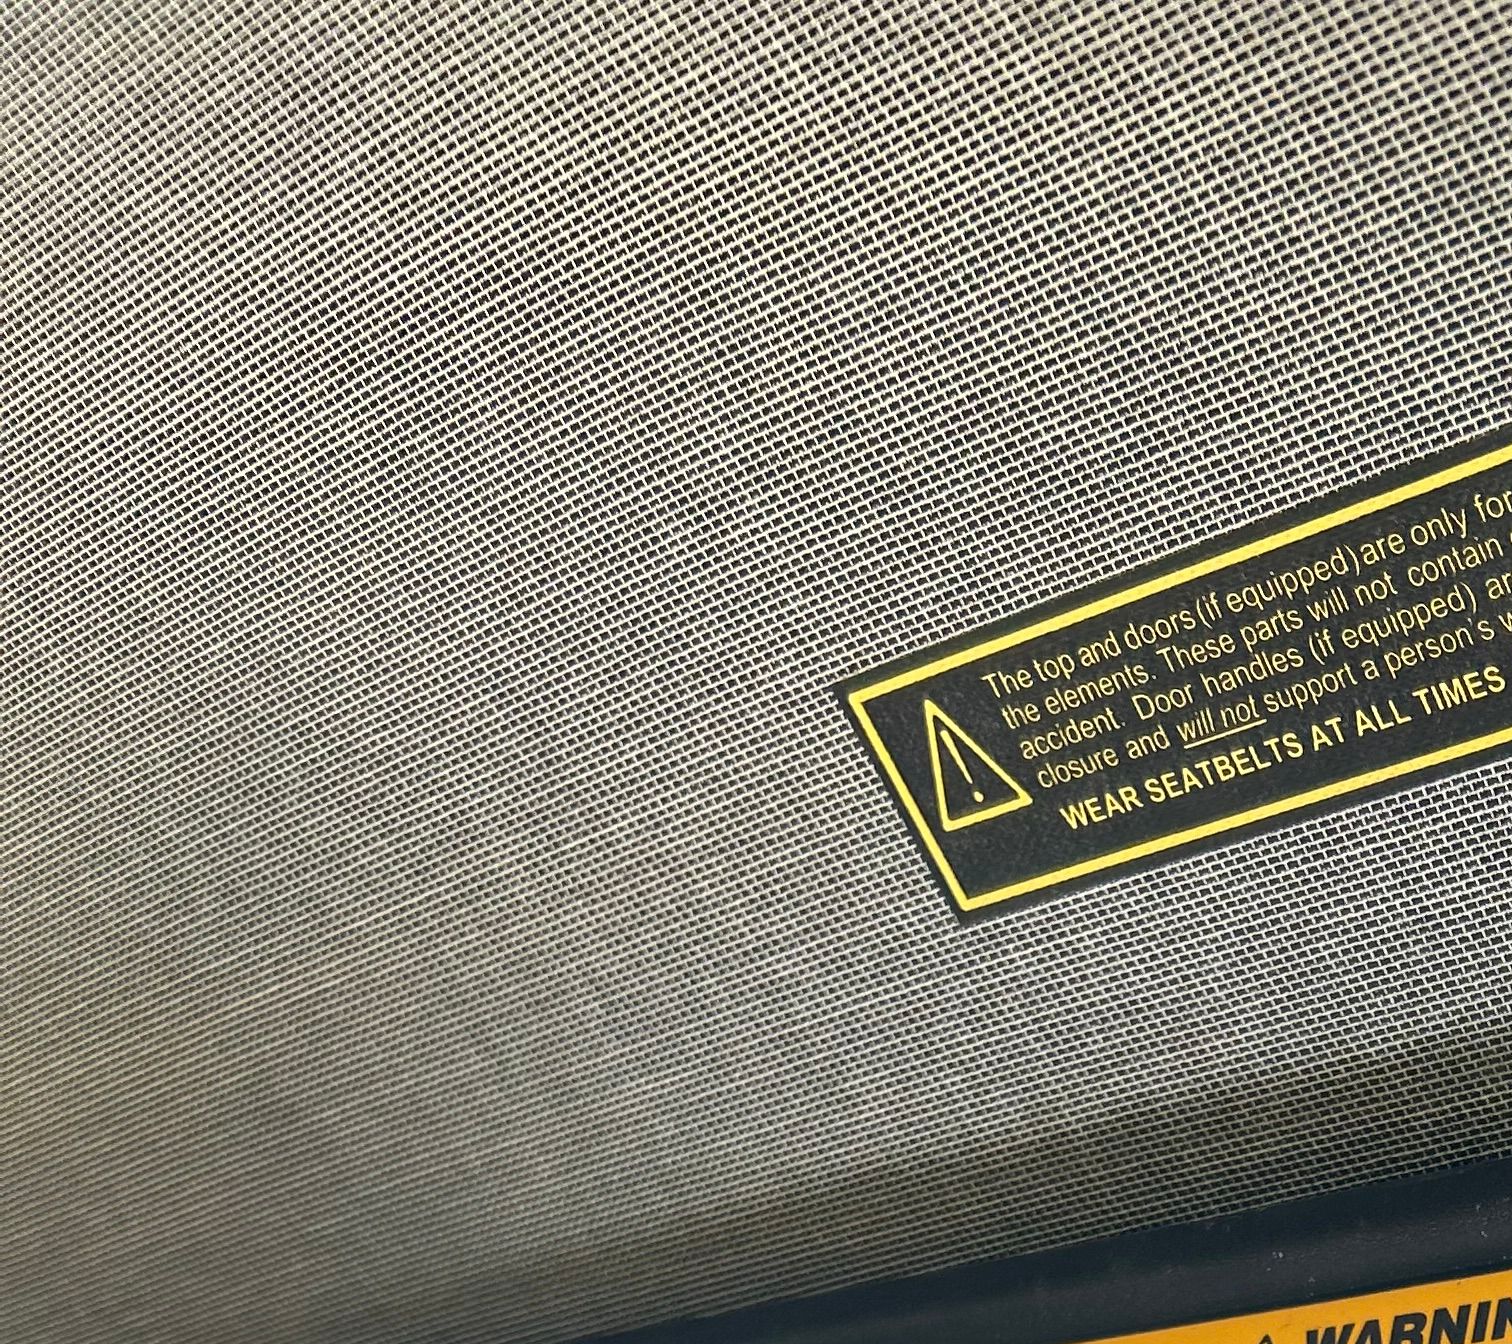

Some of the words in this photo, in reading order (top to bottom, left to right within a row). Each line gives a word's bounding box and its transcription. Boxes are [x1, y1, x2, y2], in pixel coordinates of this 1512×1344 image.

[981, 671, 1033, 698] The
[1033, 654, 1075, 680] top
[1078, 631, 1122, 667] and
[1123, 608, 1197, 651] doors
[1360, 533, 1406, 565] are
[1410, 508, 1468, 546] only
[1474, 488, 1512, 522] for
[1001, 704, 1040, 730] the
[1045, 663, 1157, 716] elements.
[1156, 633, 1236, 673] These
[1240, 608, 1303, 653] parts
[1306, 586, 1349, 623] will
[1354, 571, 1398, 606] not
[1407, 536, 1504, 587] contain
[1019, 706, 1126, 760] accident.
[1131, 682, 1194, 720] Door
[1199, 645, 1304, 697] handles
[1308, 628, 1336, 665] (if
[1341, 582, 1477, 649] equipped)
[1037, 747, 1120, 789] closure
[1125, 724, 1171, 760] and
[1176, 706, 1215, 742] will
[1220, 695, 1260, 728] not
[1263, 662, 1358, 713] support
[1360, 659, 1380, 681] a
[1383, 618, 1495, 680] person's
[1059, 786, 1144, 830] WEAR
[1143, 732, 1304, 803] SEATBELTS
[1311, 717, 1345, 751] AT
[1354, 700, 1413, 736] ALL
[1412, 665, 1507, 716] TIMES
